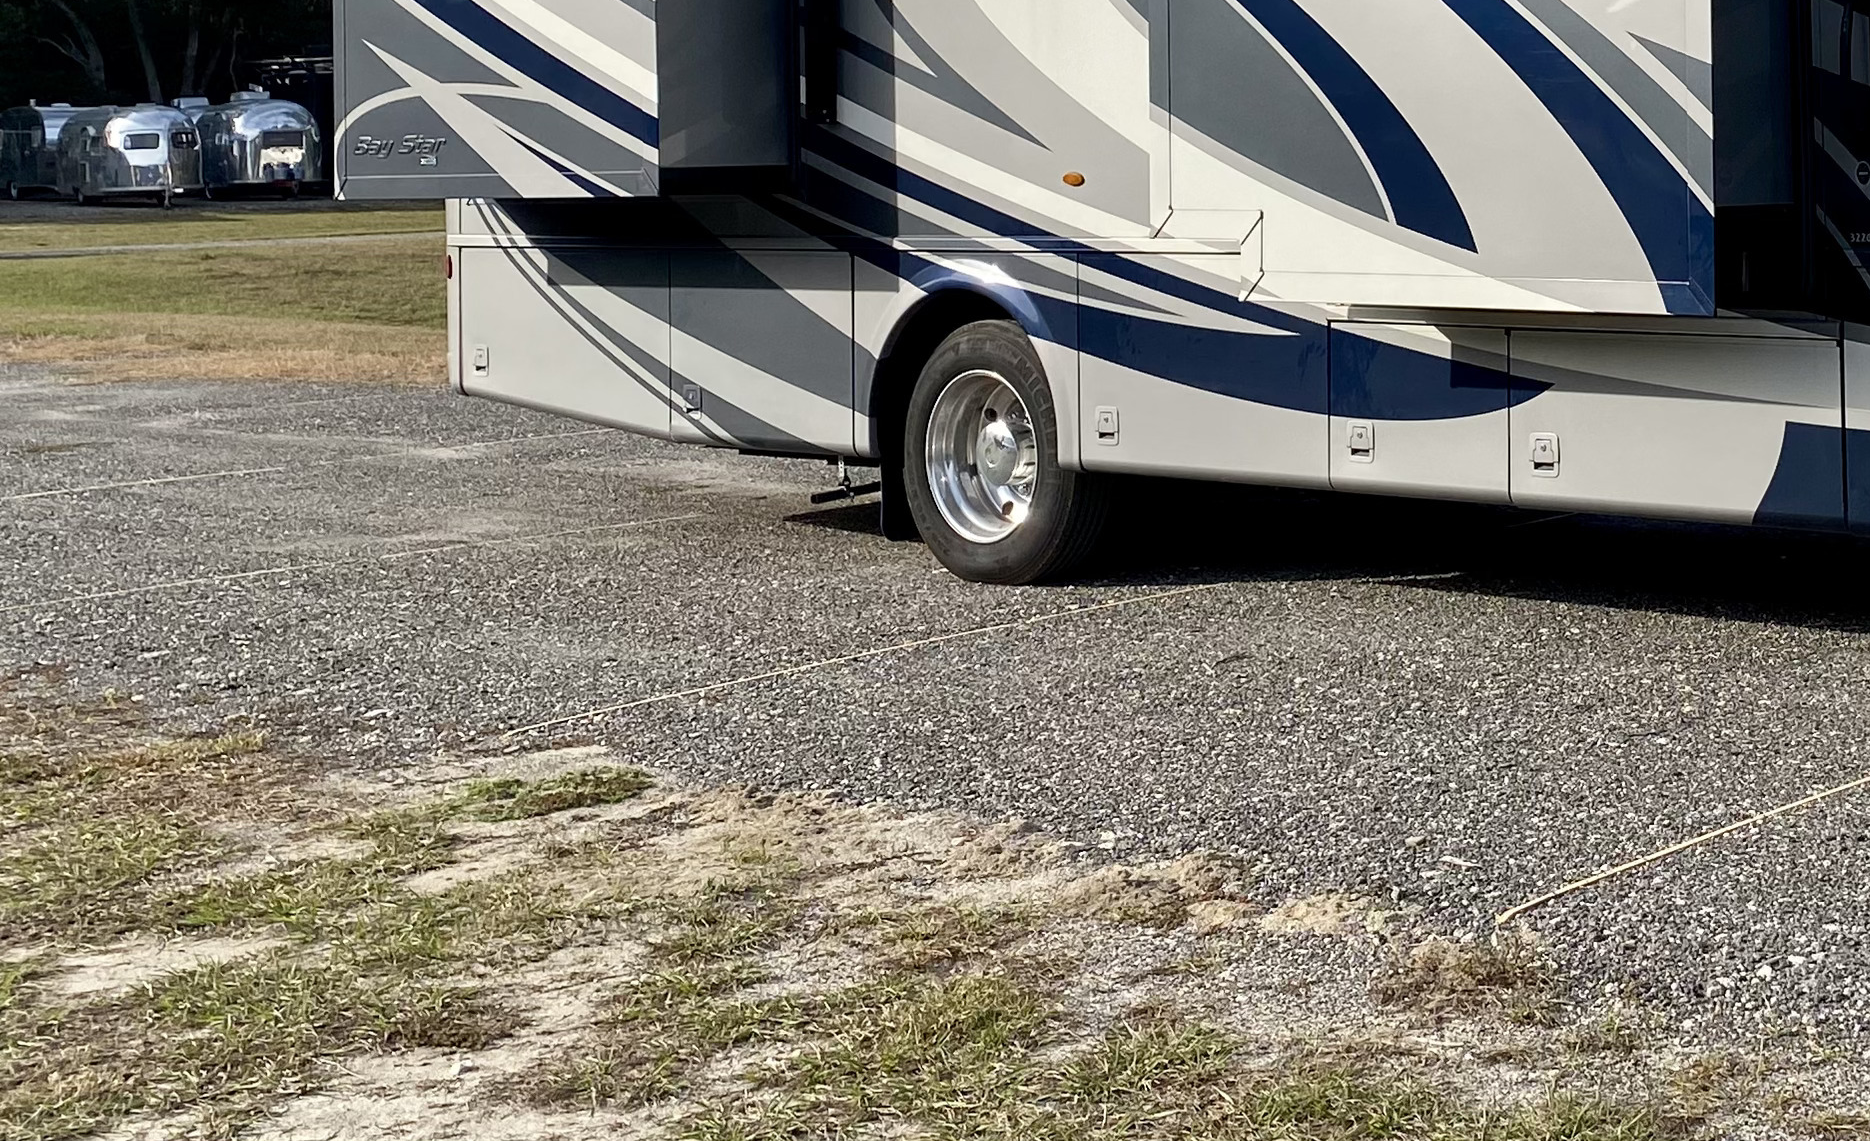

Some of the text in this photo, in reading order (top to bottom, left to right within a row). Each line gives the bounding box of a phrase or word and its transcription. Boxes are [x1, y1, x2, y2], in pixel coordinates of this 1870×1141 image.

[354, 132, 447, 159] Bay Star
[1014, 356, 1062, 499] MICHEL
